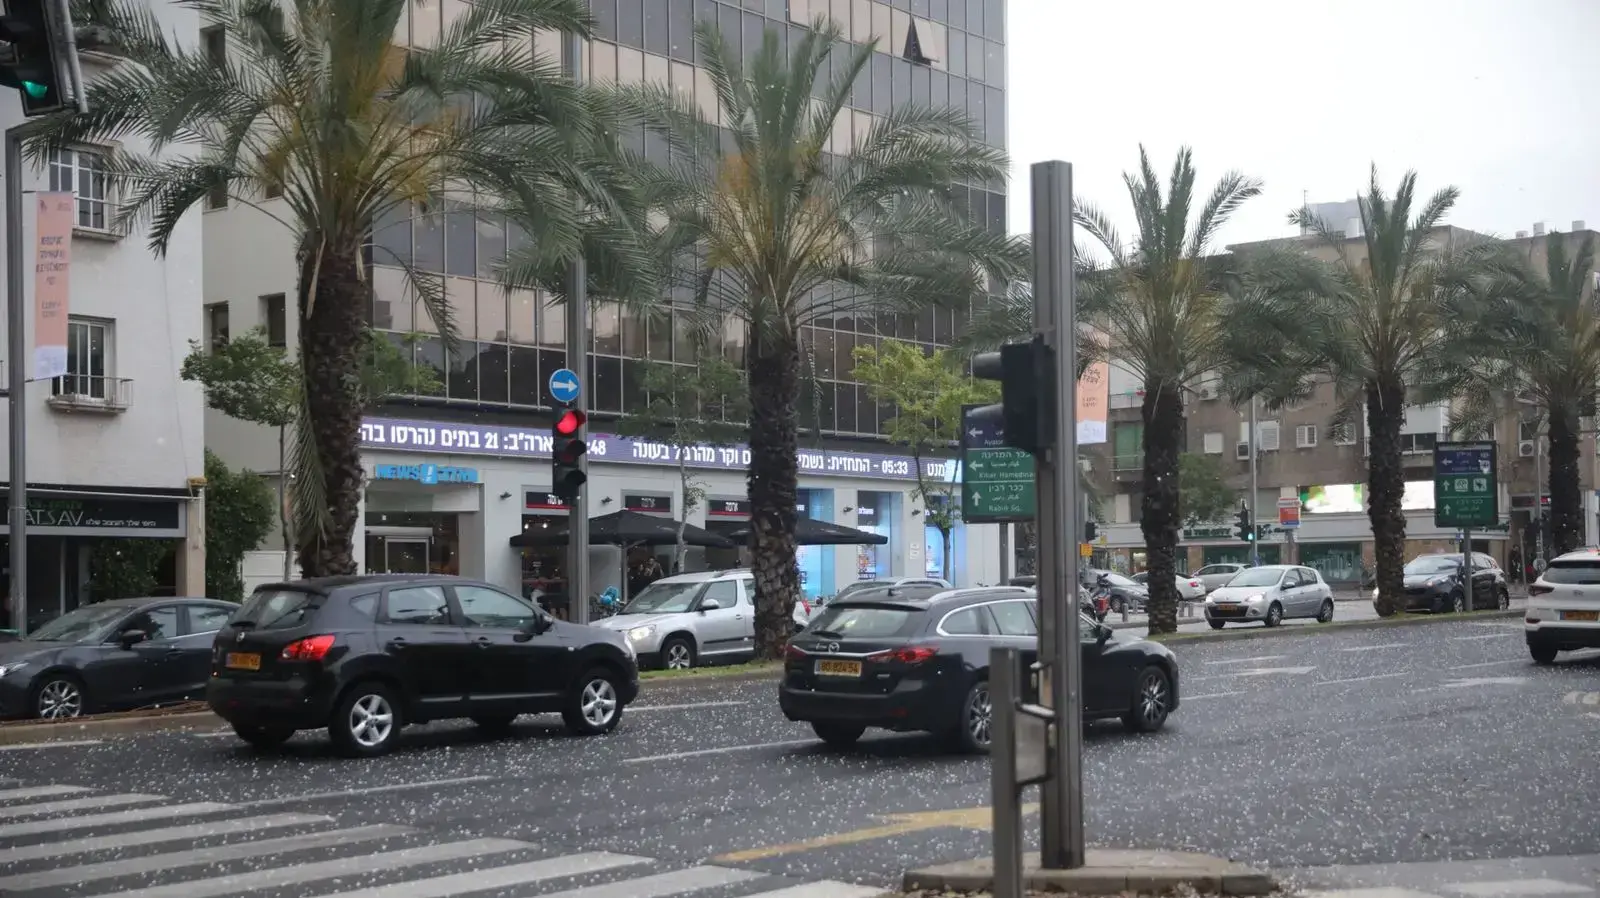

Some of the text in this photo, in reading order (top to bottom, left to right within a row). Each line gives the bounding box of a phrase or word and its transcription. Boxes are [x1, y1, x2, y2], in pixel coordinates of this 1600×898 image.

[391, 425, 436, 446] נהרסו
[441, 429, 480, 448] בתים
[484, 432, 499, 449] 21
[503, 432, 553, 453] ארה"ב:
[633, 442, 670, 460] בעונה
[719, 447, 739, 466] וקר
[796, 454, 824, 470] גשמי
[827, 455, 870, 473] התחזית:
[881, 460, 908, 475] 05:33
[376, 464, 420, 479] NEWS
[8, 508, 84, 526] ATSAV
